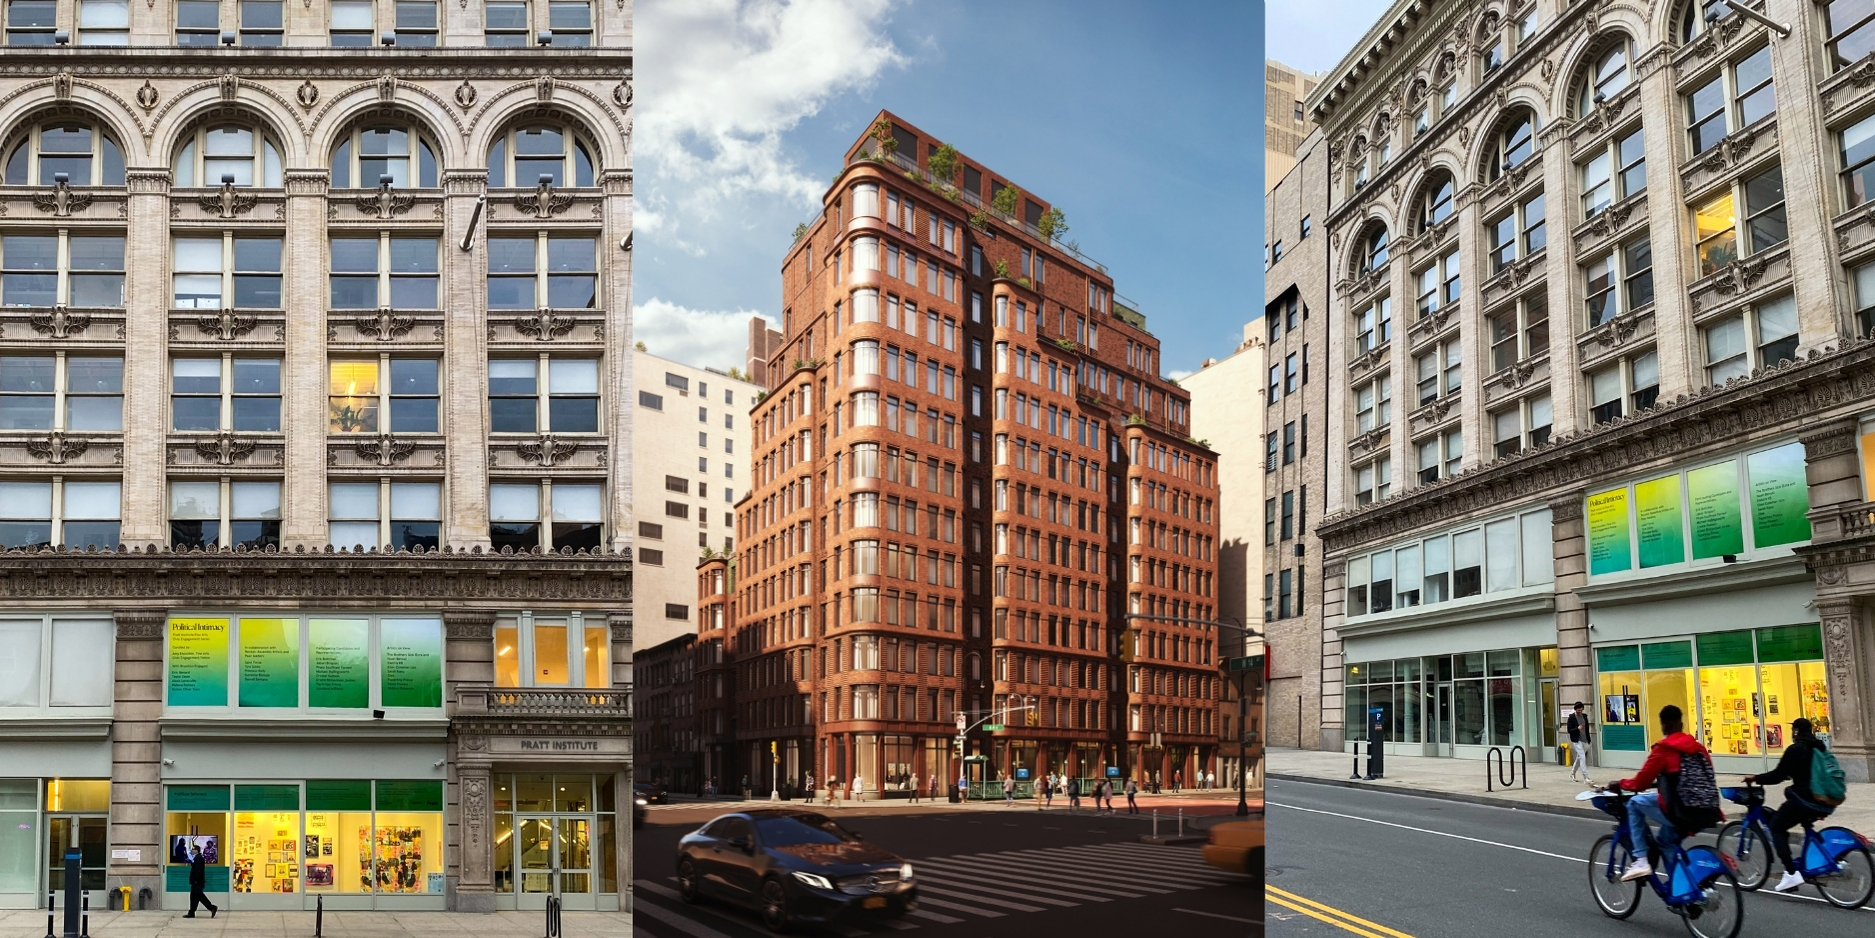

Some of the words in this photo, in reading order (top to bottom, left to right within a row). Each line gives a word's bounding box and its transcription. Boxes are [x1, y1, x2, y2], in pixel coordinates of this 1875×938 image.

[1590, 497, 1607, 507] Political
[1607, 494, 1625, 504] Intimacy
[198, 623, 225, 632] Intimacy
[521, 741, 550, 749] PRATT
[553, 741, 598, 750] INSTITUTE
